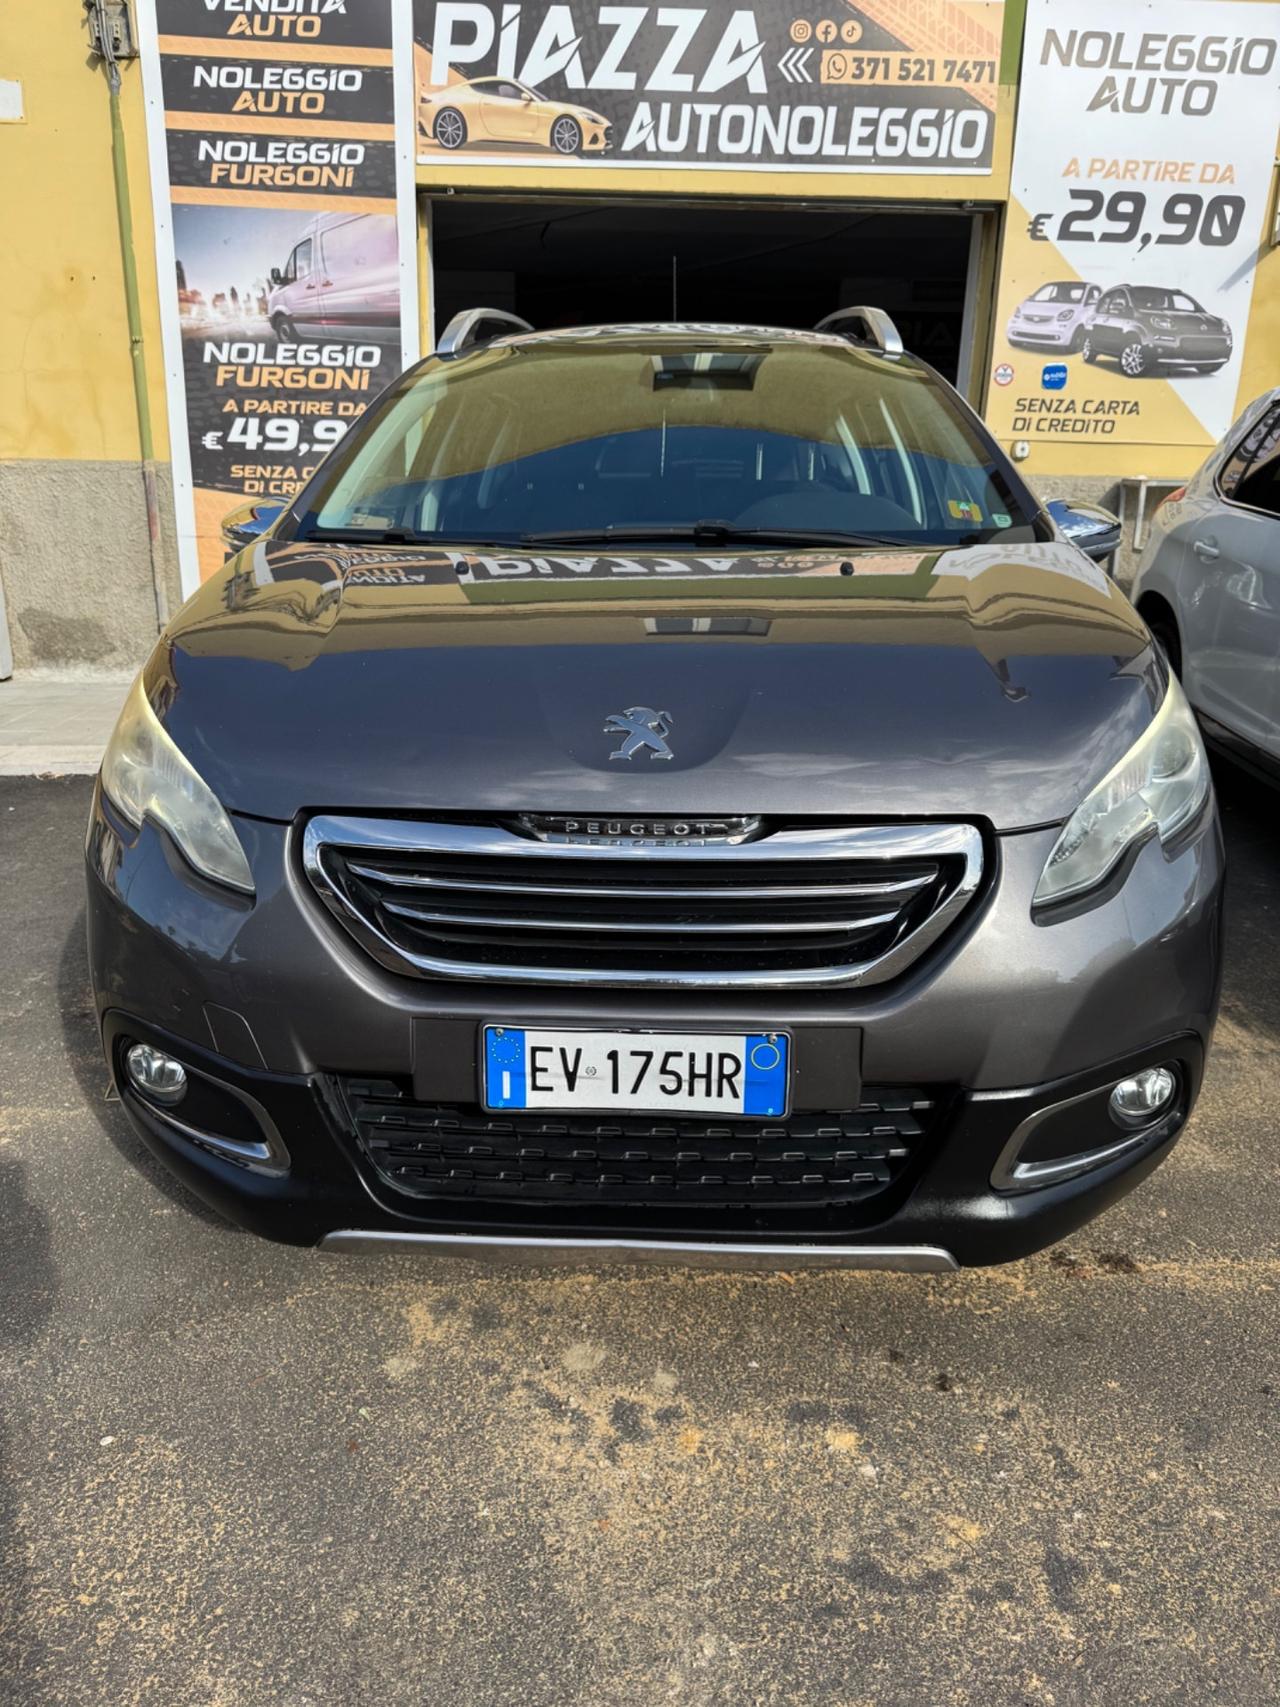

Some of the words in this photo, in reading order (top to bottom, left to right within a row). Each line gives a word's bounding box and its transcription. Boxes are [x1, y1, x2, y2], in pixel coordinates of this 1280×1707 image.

[227, 13, 322, 38] AUTO
[430, 2, 768, 94] PIAZZA
[1040, 28, 1278, 76] NOLEGGIO
[193, 65, 363, 92] NOLEGGIO
[851, 56, 890, 80] 371
[897, 58, 935, 82] 521
[943, 60, 996, 83] 7471
[231, 90, 325, 114] AUTO
[1086, 76, 1218, 116] AUTO
[621, 101, 988, 159] AUTONOLEGGIO
[198, 139, 365, 165] NOLEGGIO
[210, 163, 354, 188] FURGONI
[1061, 157, 1081, 178] A
[1087, 158, 1195, 183] PARTIRE
[1198, 163, 1236, 184] DA
[203, 342, 382, 368] NOLEGGIO
[216, 365, 370, 391] FURGONI
[222, 398, 239, 413] A
[243, 399, 333, 416] PARTIRE
[1015, 397, 1077, 415] SENZA
[1081, 399, 1140, 416] CARTA
[1012, 417, 1032, 432] DI
[1036, 418, 1116, 434] CREDITO
[230, 464, 297, 480] SENZA
[244, 480, 264, 493] DI
[565, 821, 708, 836] PEUGEOT
[530, 1046, 582, 1092] EV
[606, 1050, 742, 1099] 175HR
